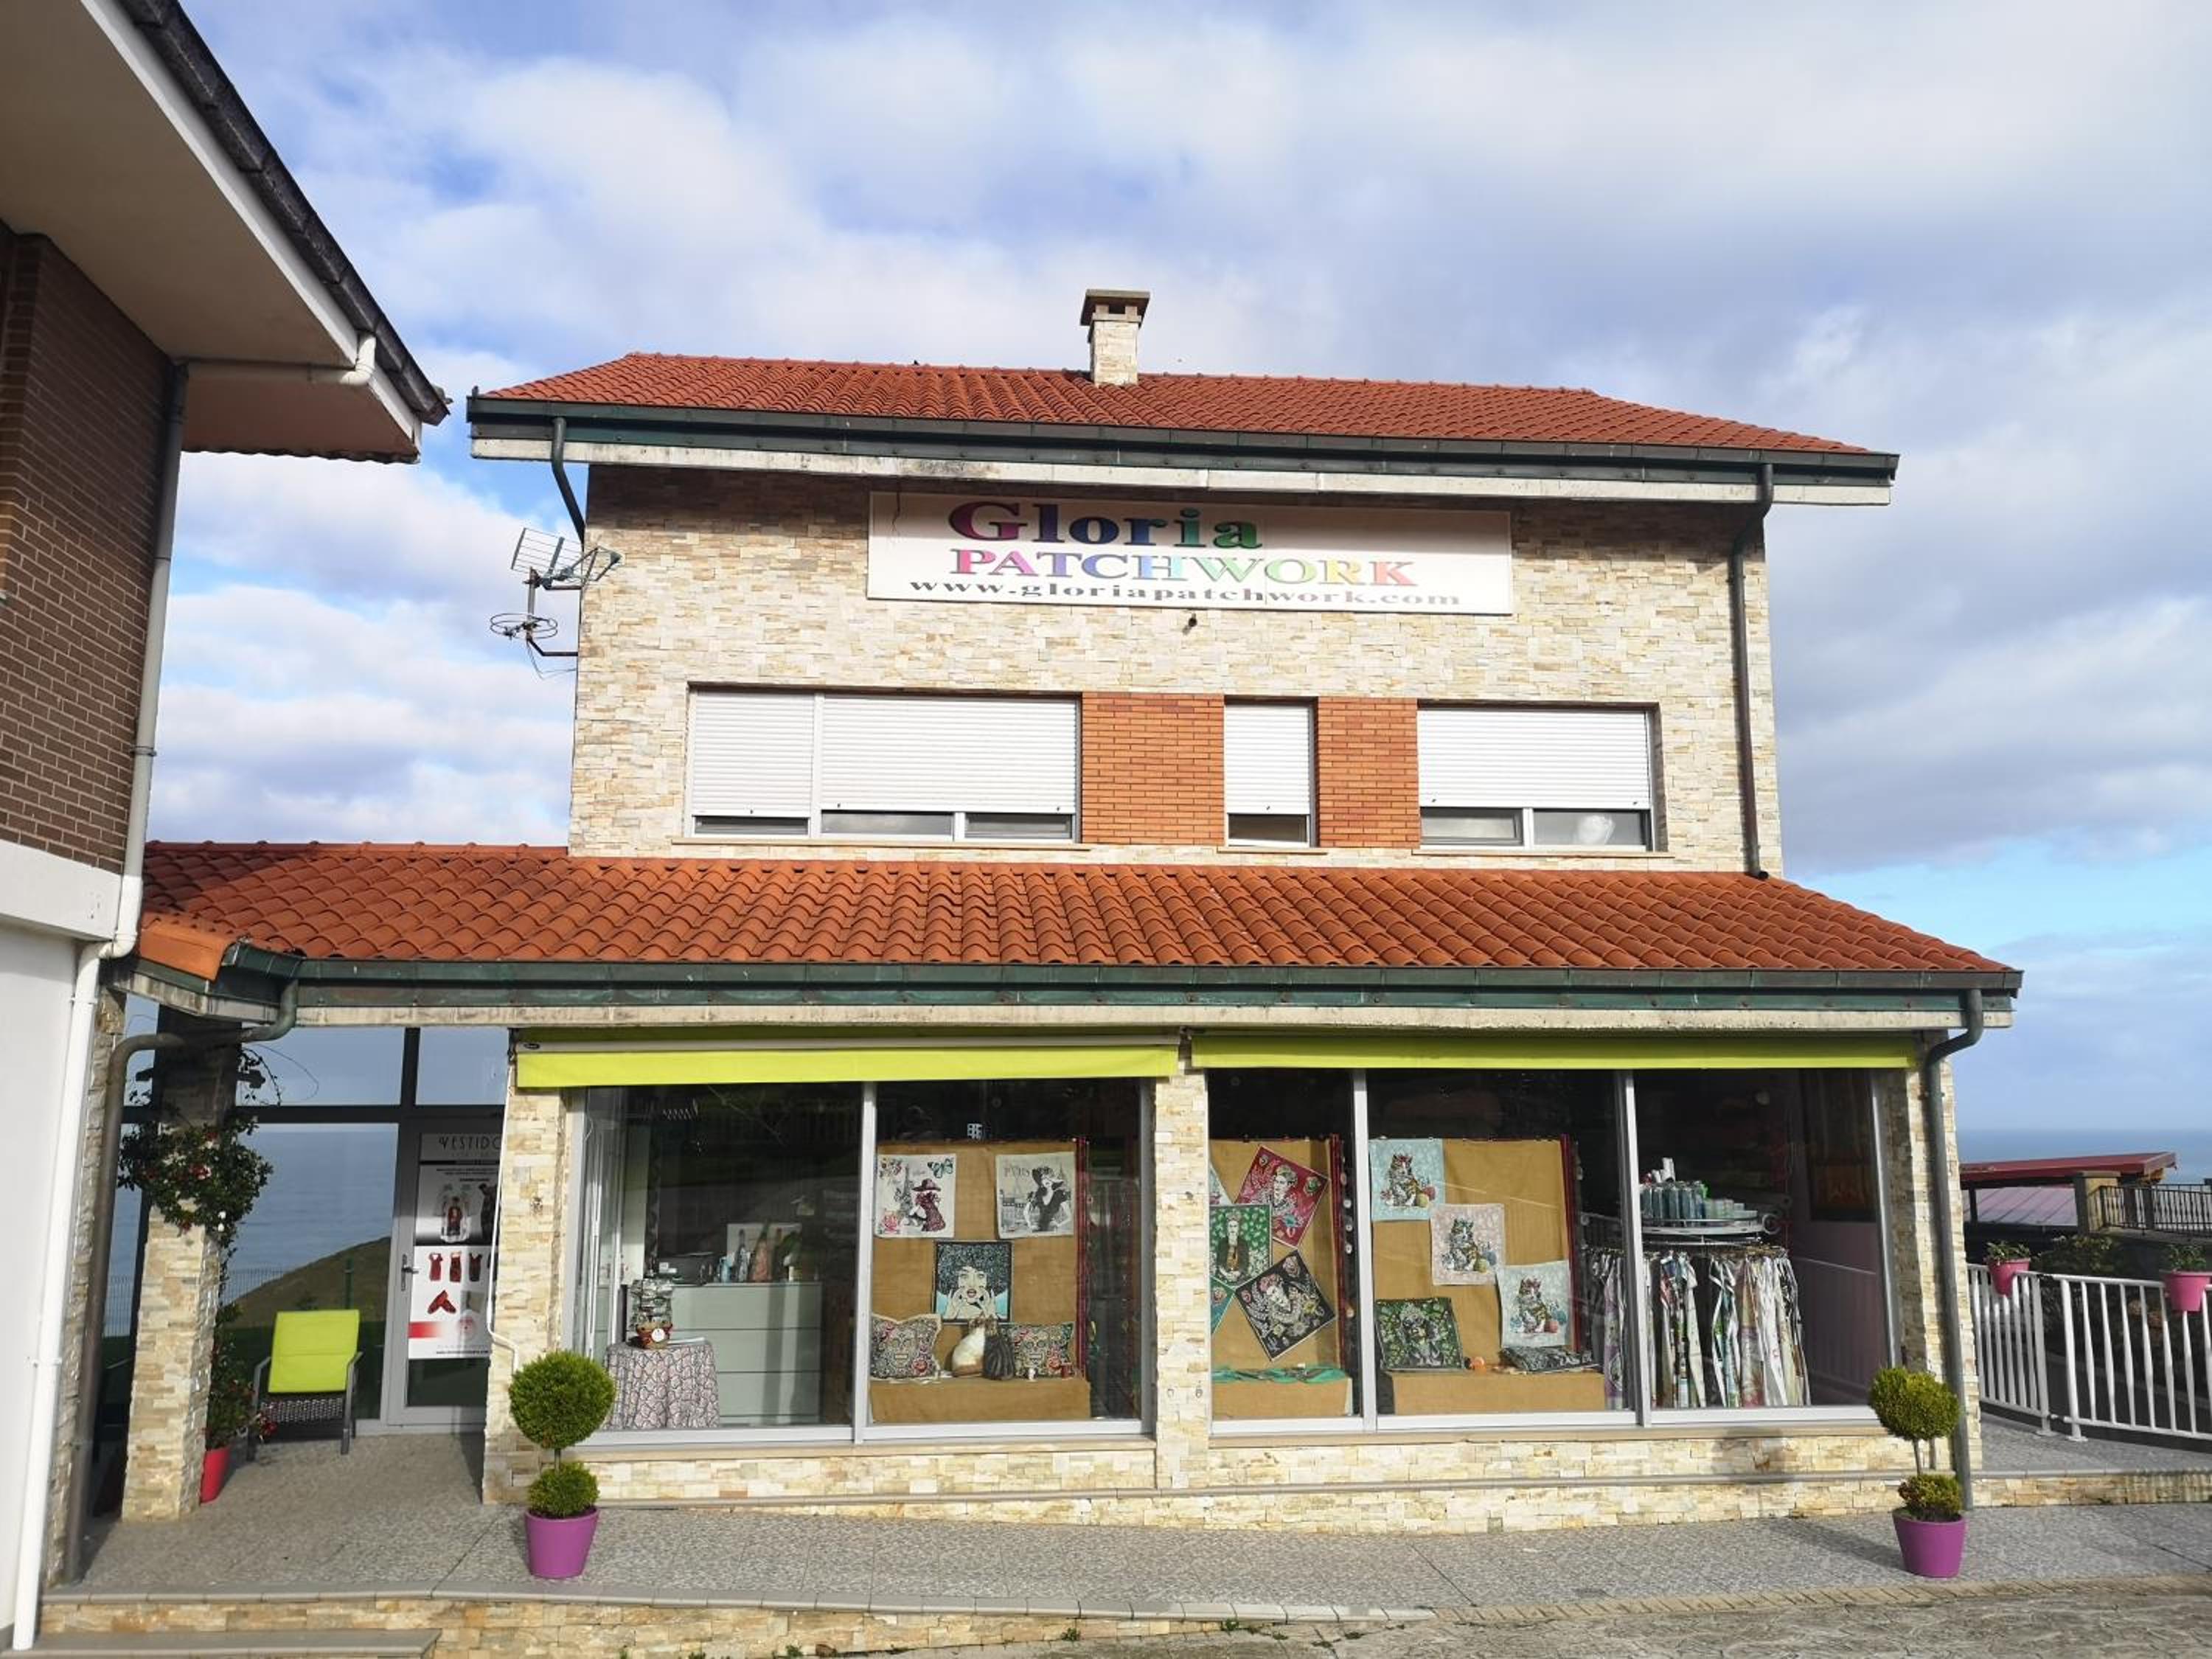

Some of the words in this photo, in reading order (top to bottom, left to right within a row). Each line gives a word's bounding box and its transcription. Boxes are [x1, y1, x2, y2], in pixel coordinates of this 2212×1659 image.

[948, 501, 1262, 549] Gloria
[949, 548, 1418, 587] PATCHWORK
[910, 581, 1460, 605] www.gloriapatchwork.com
